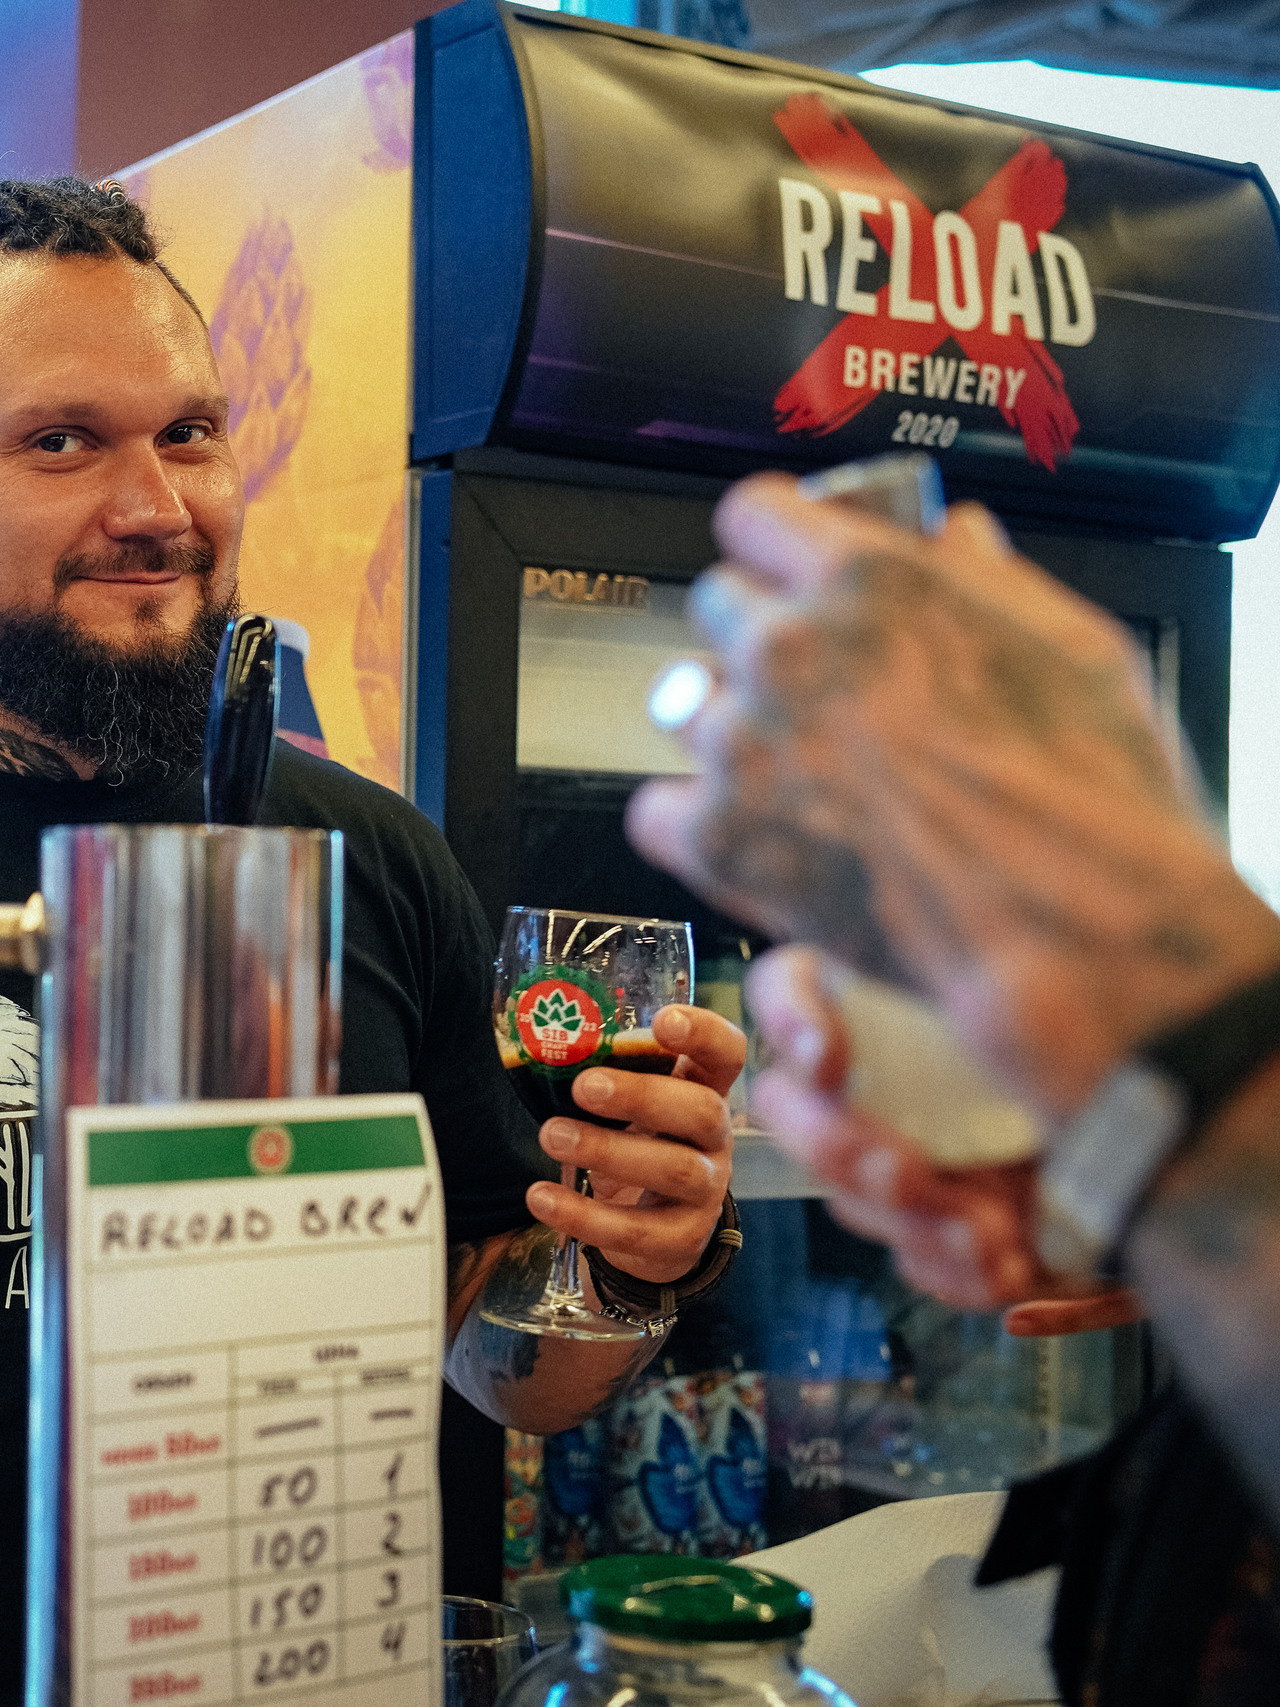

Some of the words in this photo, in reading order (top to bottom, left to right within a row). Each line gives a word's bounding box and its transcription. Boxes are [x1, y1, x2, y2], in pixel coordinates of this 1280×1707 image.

[778, 177, 1097, 347] RELOAD
[843, 344, 1027, 410] BREWERY
[891, 410, 961, 449] 2020
[522, 566, 651, 609] POLAIR
[541, 1047, 568, 1060] FEST
[542, 1027, 569, 1042] SIB
[101, 1209, 273, 1254] RELOAD
[253, 1526, 328, 1569] 100
[383, 1510, 402, 1556] 2
[375, 1569, 400, 1609] 3
[380, 1622, 406, 1662] 4
